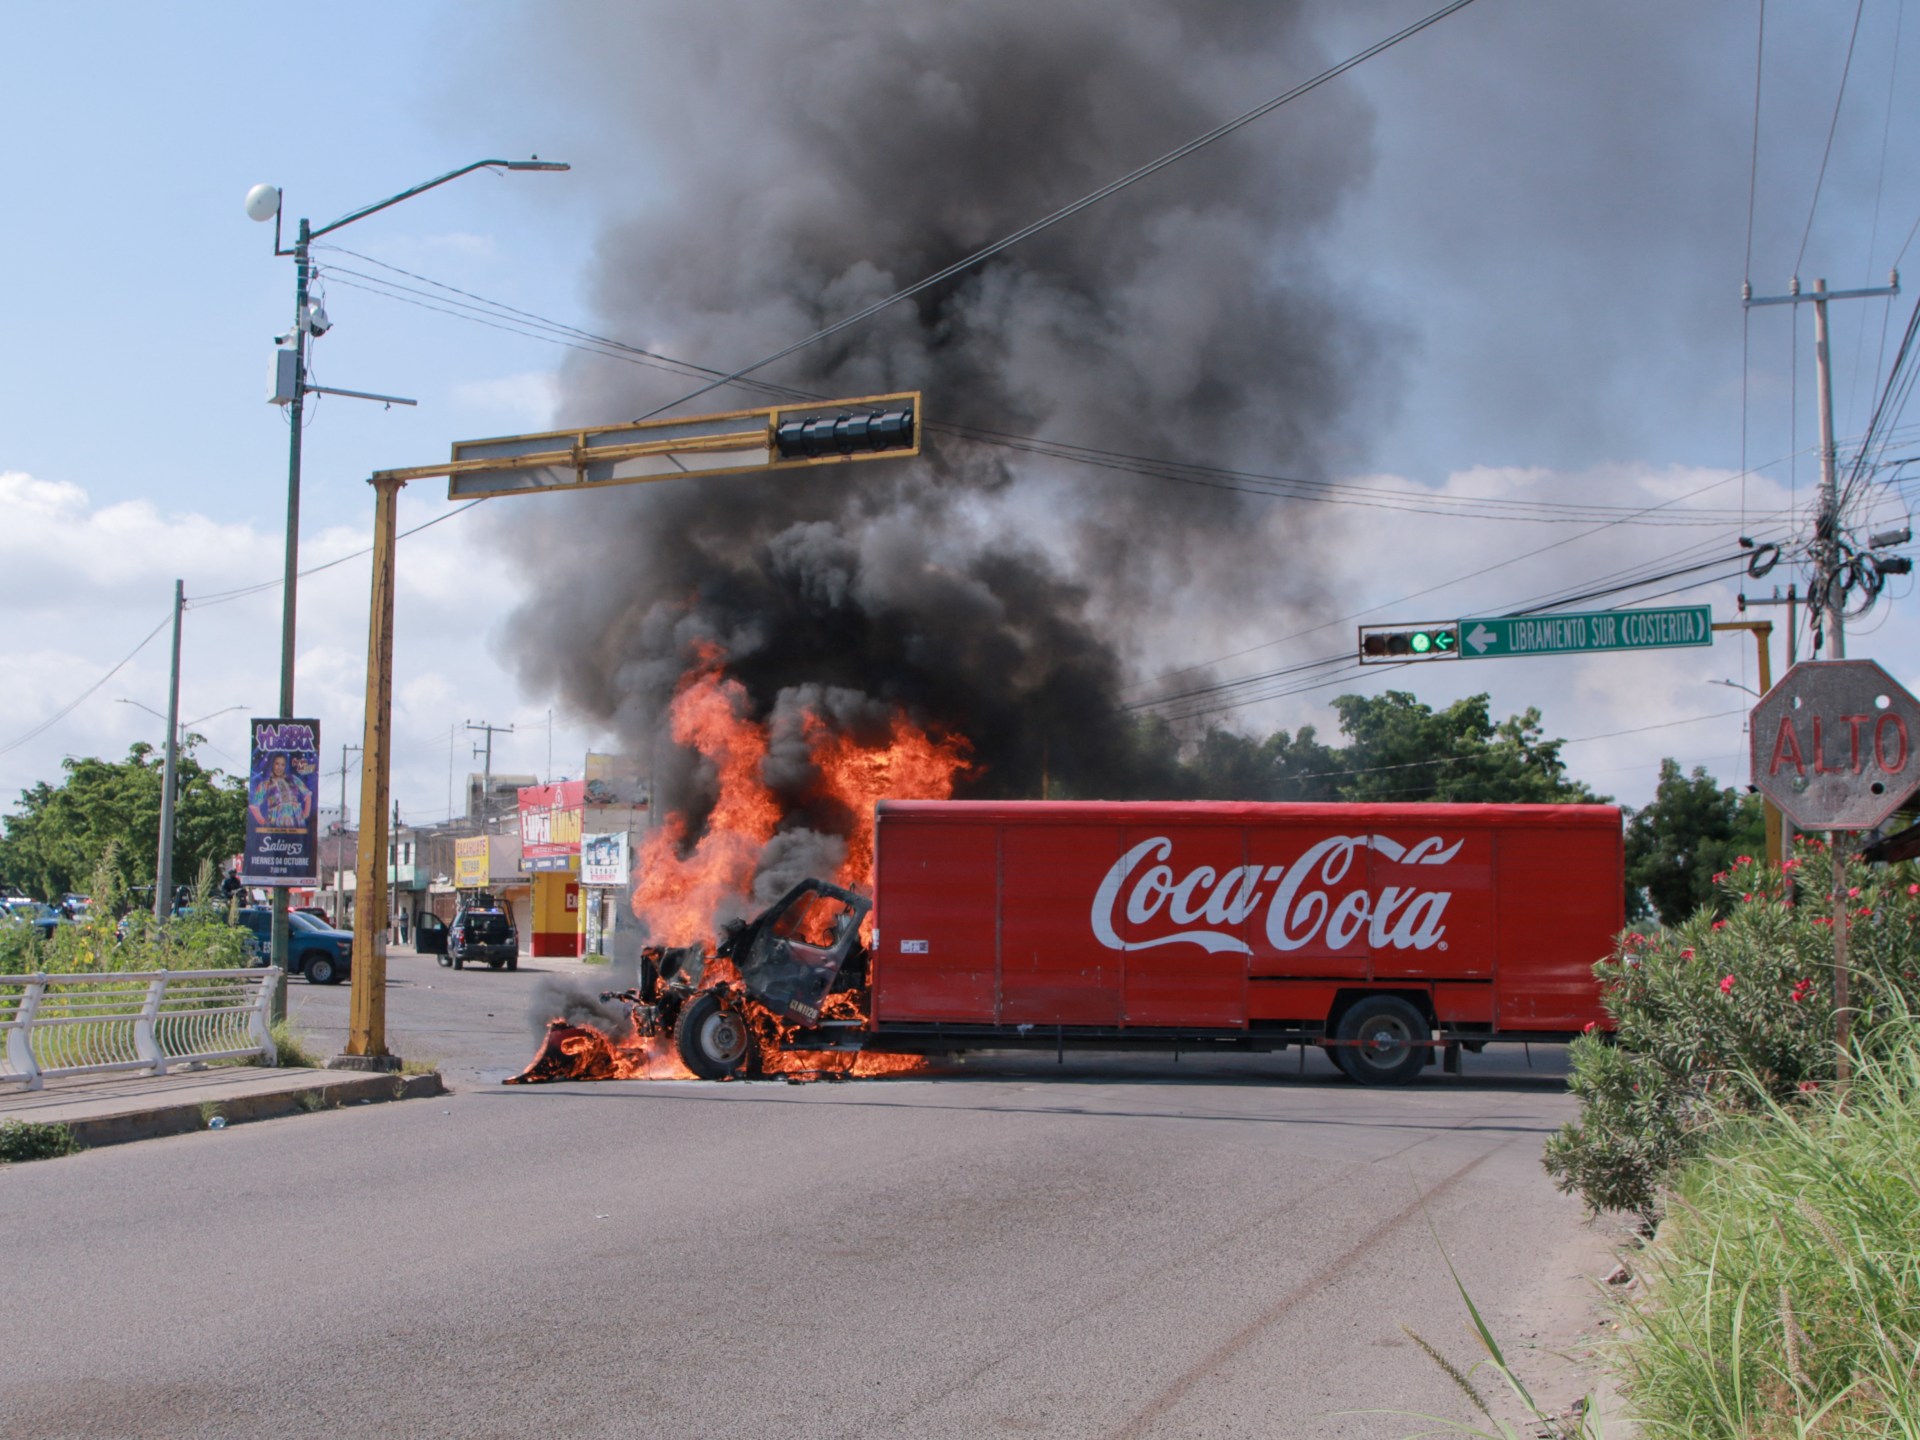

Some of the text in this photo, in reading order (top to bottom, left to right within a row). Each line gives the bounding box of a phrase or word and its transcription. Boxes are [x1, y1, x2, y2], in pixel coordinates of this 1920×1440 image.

[1508, 611, 1705, 651] LIBRAMIENTO SUR (COSTERITA)
[278, 724, 315, 740] INDIA
[1769, 712, 1908, 777] ALTO
[251, 856, 275, 866] VIERNES
[275, 857, 283, 866] 04
[283, 857, 310, 866] OCTUBRE
[1091, 834, 1464, 955] Coca-Cola
